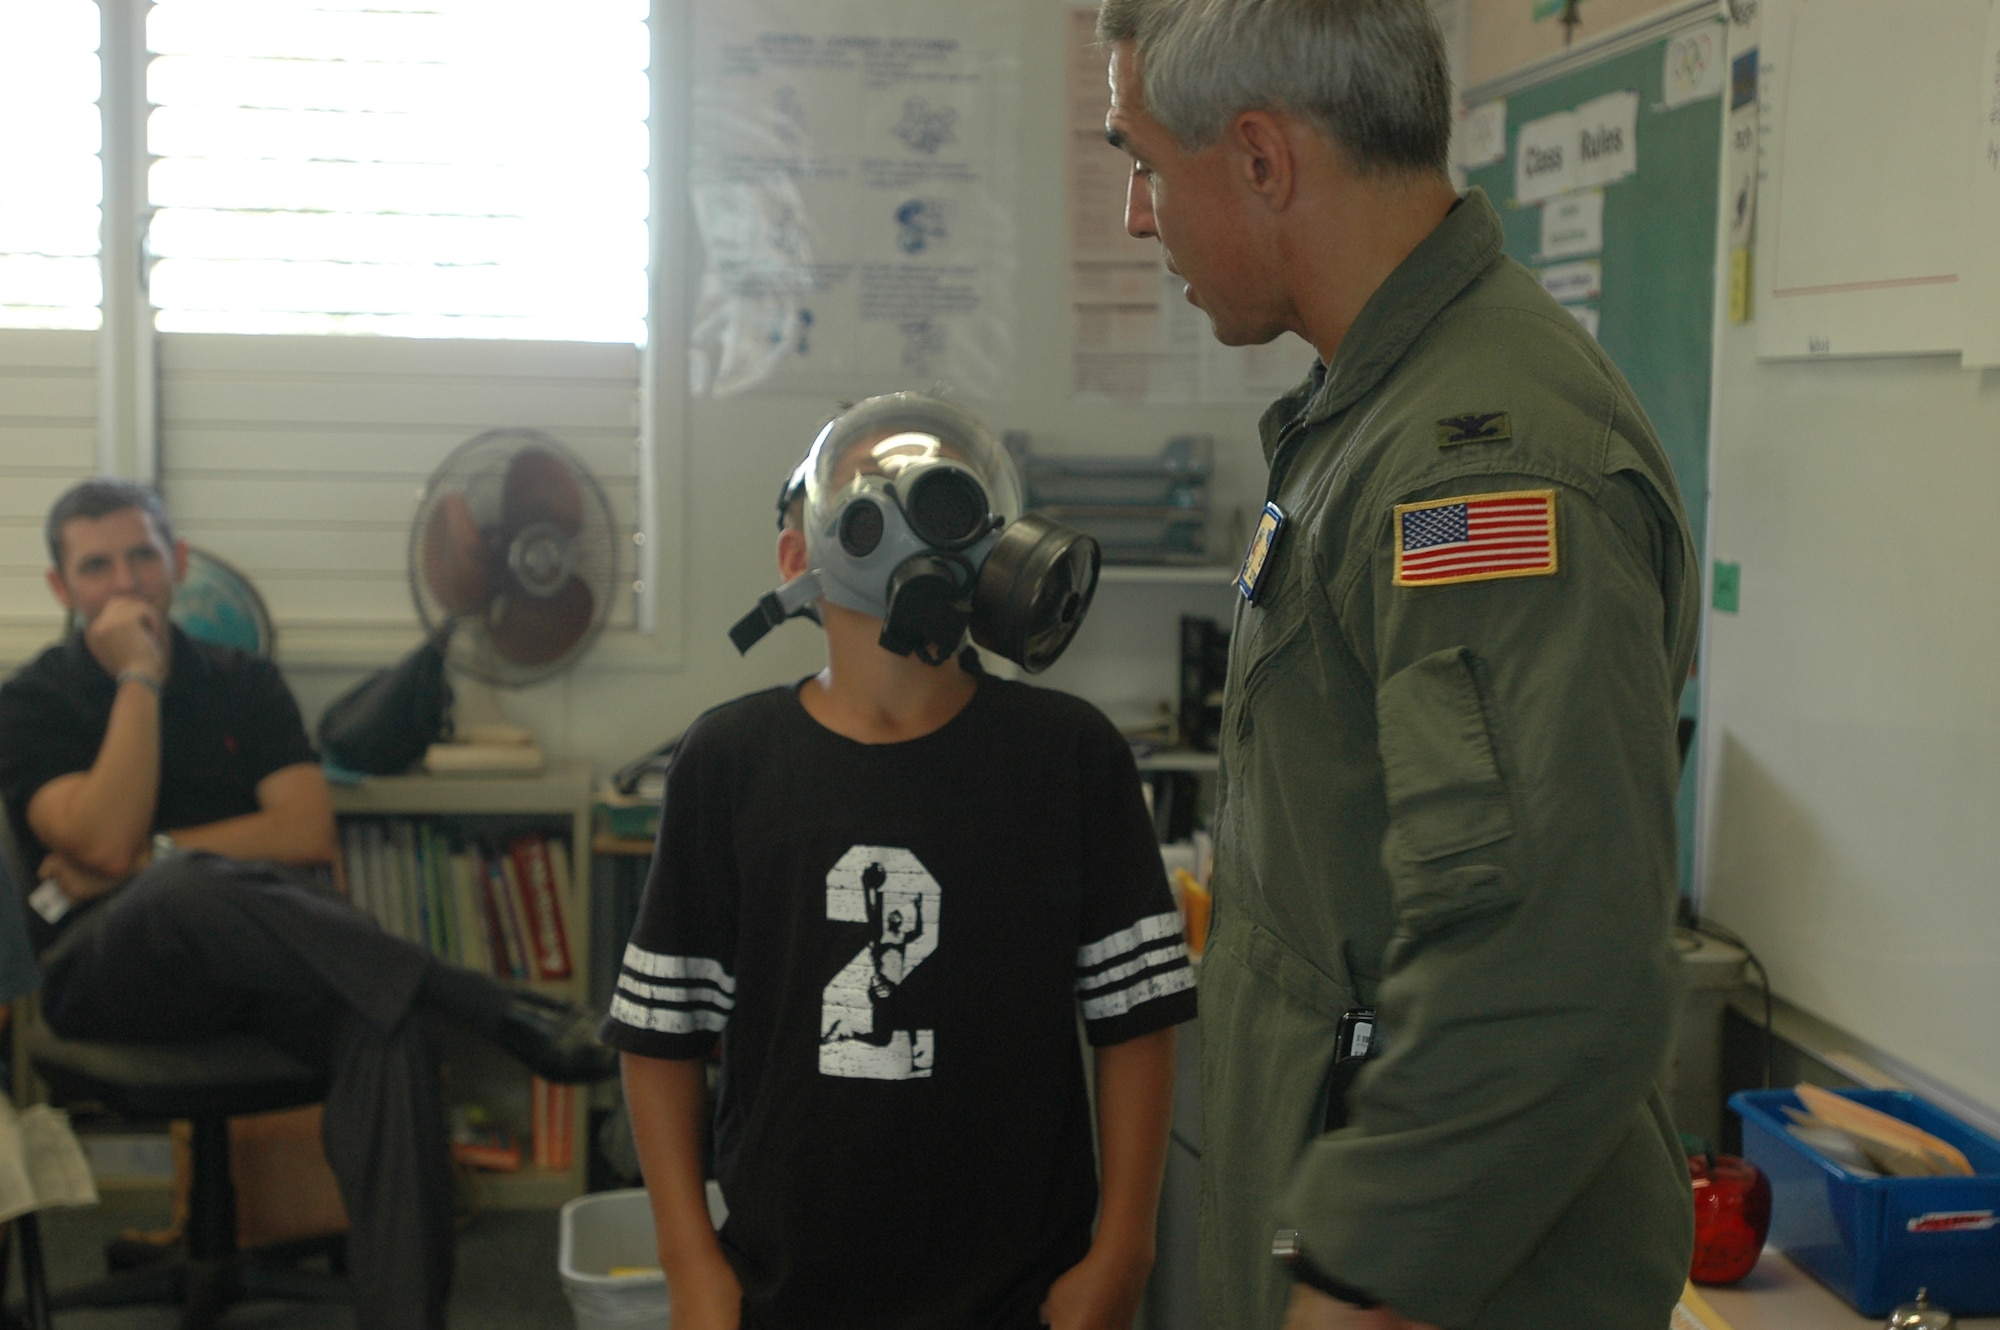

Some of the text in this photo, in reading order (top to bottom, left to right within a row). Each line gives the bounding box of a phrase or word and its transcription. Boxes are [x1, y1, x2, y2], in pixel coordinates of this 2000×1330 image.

[1525, 123, 1623, 178] Class Rules
[818, 844, 942, 1080] 2
